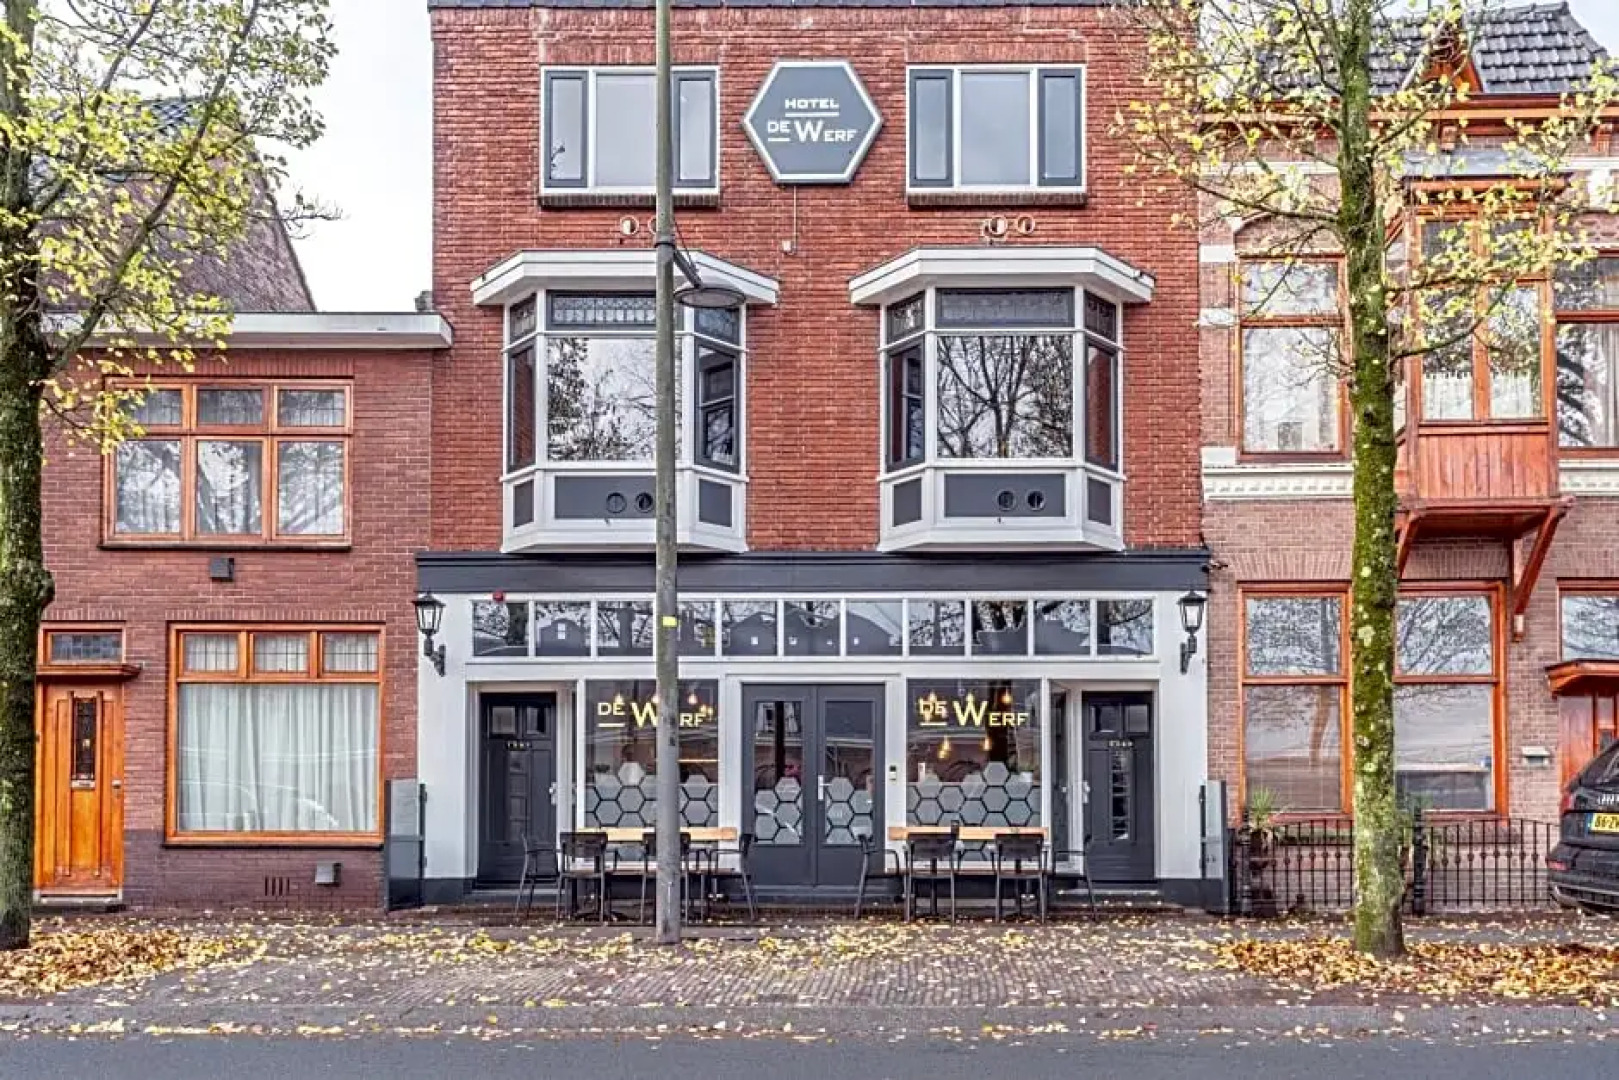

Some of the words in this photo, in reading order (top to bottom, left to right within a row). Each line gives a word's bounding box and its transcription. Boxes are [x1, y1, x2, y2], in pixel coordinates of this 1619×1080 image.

[784, 98, 839, 109] HOTEL
[767, 120, 790, 133] DE
[597, 702, 626, 716] DE
[630, 702, 705, 728] WRF
[919, 700, 947, 716] DE
